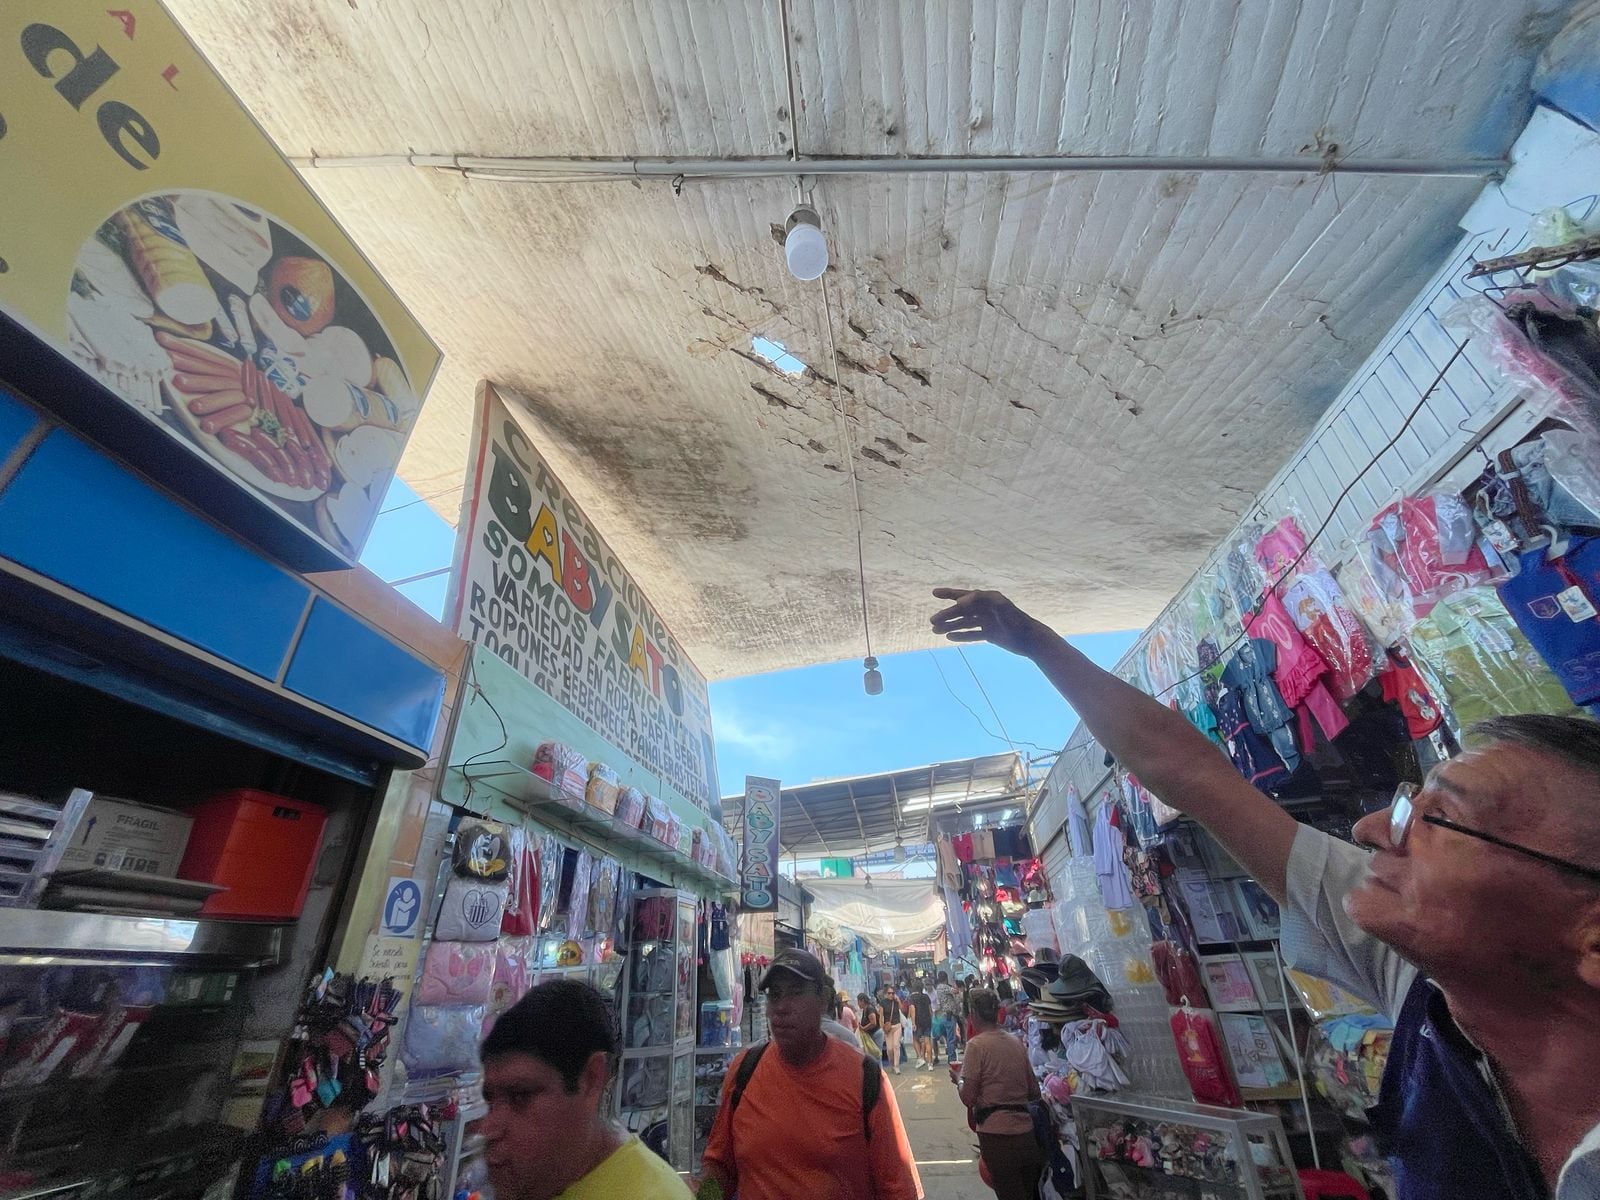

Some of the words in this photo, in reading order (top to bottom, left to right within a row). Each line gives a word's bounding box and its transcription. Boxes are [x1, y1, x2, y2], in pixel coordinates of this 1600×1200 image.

[21, 22, 161, 171] de
[483, 519, 588, 645] SOMOS
[488, 438, 613, 630] BABY
[611, 601, 685, 717] SATO
[492, 560, 583, 673] VARIEDAD
[587, 656, 603, 694] EN
[606, 677, 638, 729] ROPA
[641, 711, 672, 753] PAPA
[116, 814, 160, 831] FRAGIL
[745, 848, 771, 907] SATO
[746, 787, 774, 844] BABY
